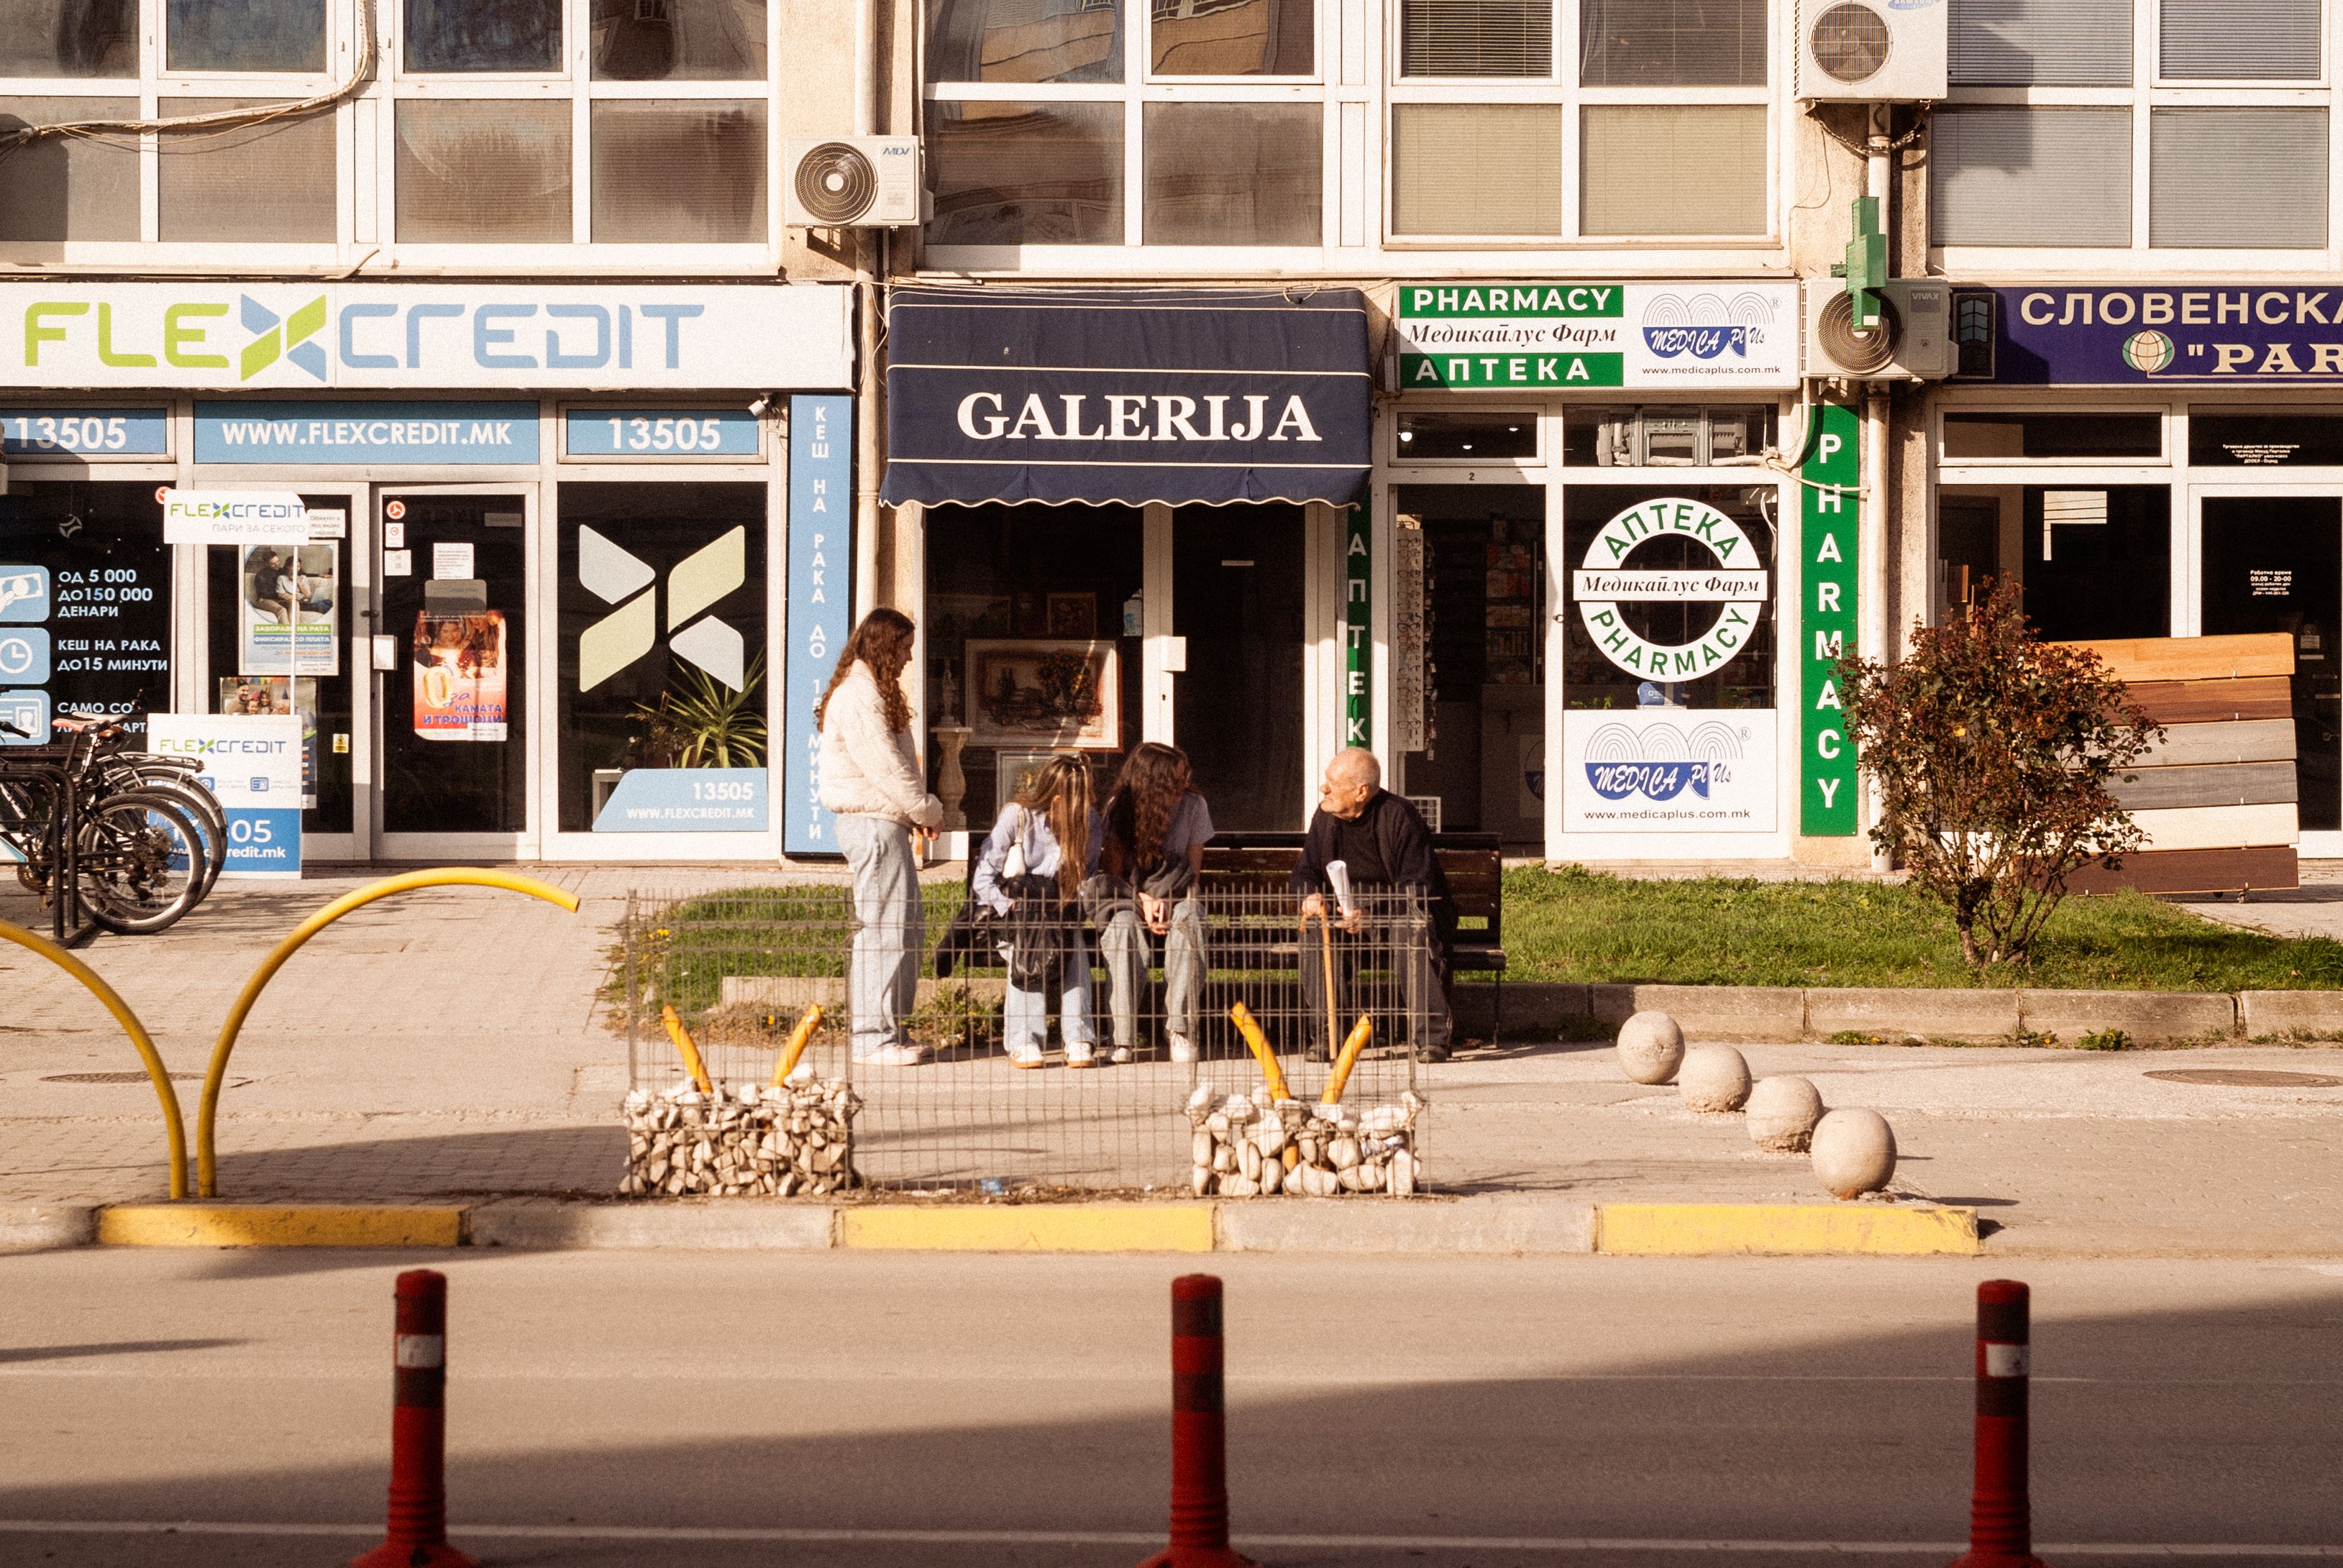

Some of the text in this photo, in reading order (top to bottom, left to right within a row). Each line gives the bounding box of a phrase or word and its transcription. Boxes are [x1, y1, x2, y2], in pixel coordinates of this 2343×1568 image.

[1413, 288, 1612, 312] PHARMACY
[1551, 325, 1617, 347] Фарм
[1650, 329, 1720, 355] MEDICA
[1415, 358, 1590, 381] АПТЕКА
[1642, 365, 1781, 376] www.medicaplus.com.mk
[956, 392, 1322, 441] GALERIJA
[14, 416, 126, 449] 13505
[222, 422, 512, 445] WWW.FLEXCREDIT.MK
[608, 418, 721, 451] 13505
[811, 406, 828, 458] КЕШ
[1469, 472, 1475, 481] 2
[812, 479, 826, 513] НА
[213, 524, 305, 533] ПАРИ ЗА СЕКОГО
[1604, 503, 1740, 561] АПТЕКА
[58, 569, 137, 584] ОД 5 000
[811, 533, 826, 603] РАКА
[120, 587, 152, 602] 000
[1704, 575, 1759, 596] Фарм
[58, 606, 119, 618] ДЕНАРИ
[1815, 433, 1842, 808] PHARMACY
[58, 640, 160, 651] КЕШ НА РАКА
[1347, 533, 1366, 741] АПТЕК
[1590, 608, 1749, 675] PHARMACY
[107, 659, 168, 671] МИНУТИ
[58, 702, 133, 714] САМО СО
[434, 715, 503, 725] ТРОШОЦИ
[1594, 764, 1679, 795] MEDICA
[693, 781, 754, 801] 13505
[627, 807, 754, 820] WWW.FLEXCREDIT.MK
[1584, 809, 1751, 821] www.medicaplus.com.mk
